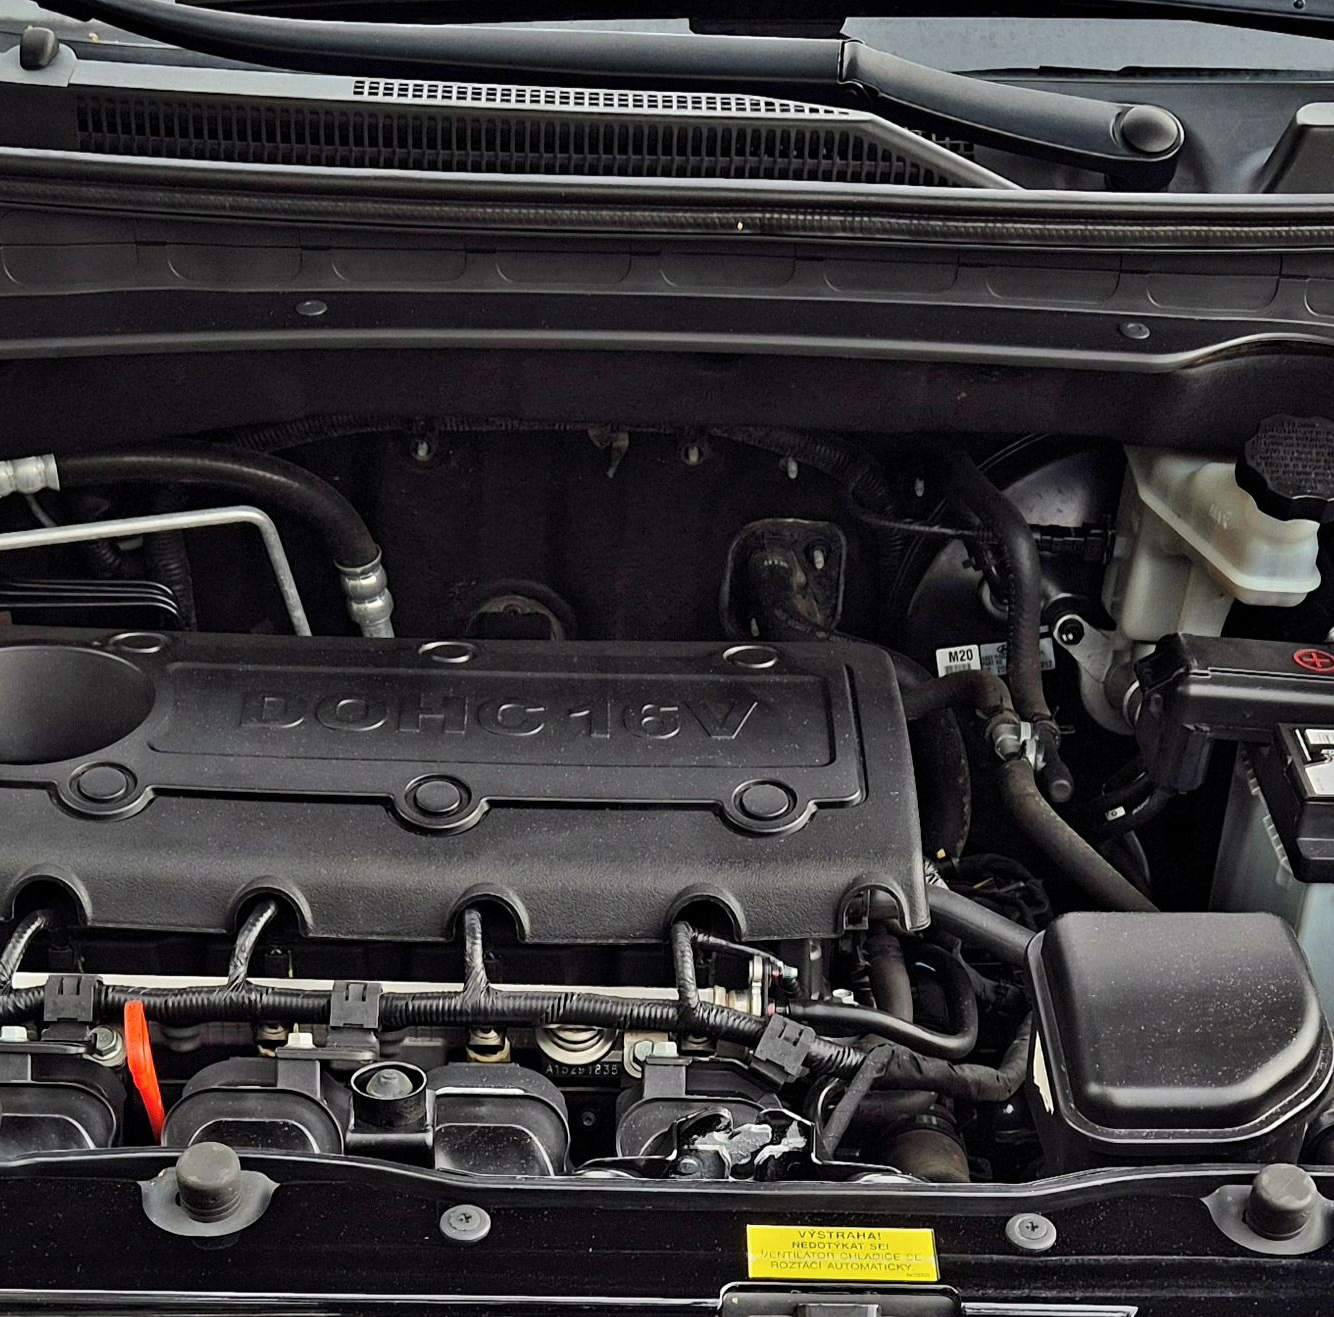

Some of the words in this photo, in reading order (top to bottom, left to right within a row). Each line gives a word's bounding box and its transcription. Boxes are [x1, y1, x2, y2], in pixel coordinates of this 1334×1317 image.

[948, 649, 973, 663] M20
[239, 696, 545, 737] DOHC
[568, 698, 759, 739] 16V
[798, 1229, 882, 1241] VÝSTRAHA!
[792, 1241, 864, 1251] NEDOTÝKAT
